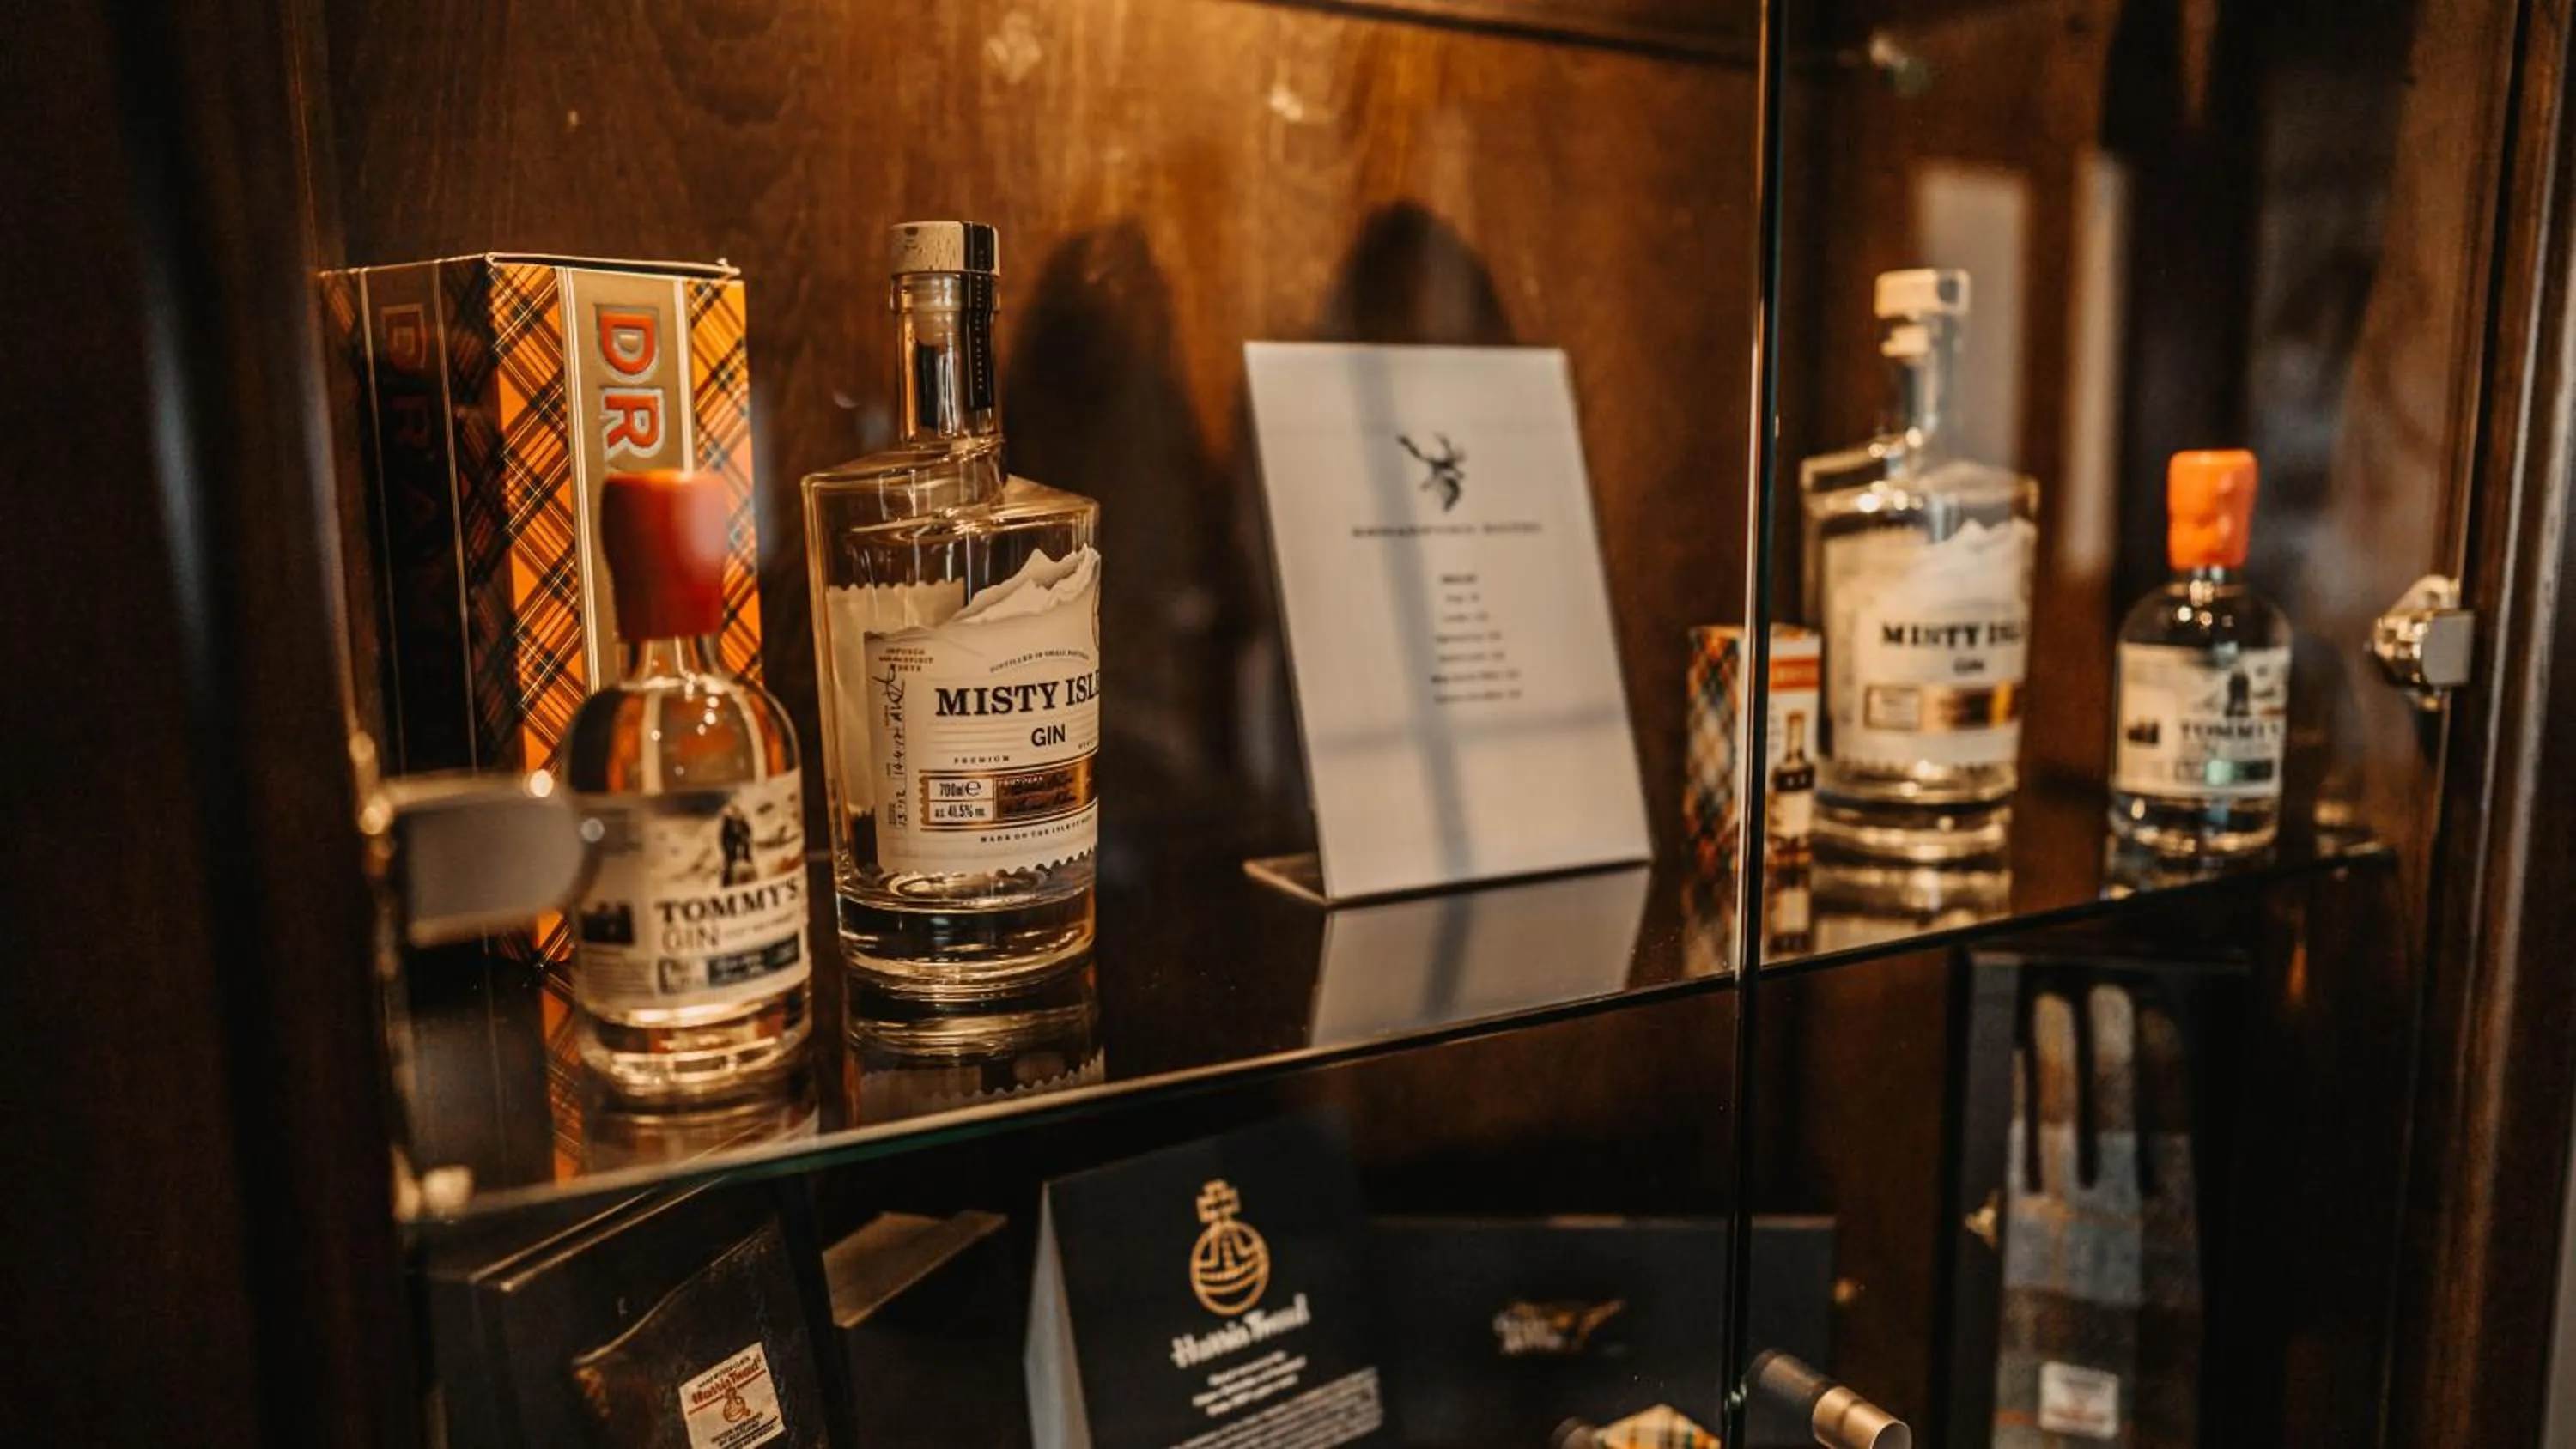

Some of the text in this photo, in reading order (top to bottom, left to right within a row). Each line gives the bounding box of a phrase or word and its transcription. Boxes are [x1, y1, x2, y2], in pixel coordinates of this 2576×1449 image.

[596, 303, 667, 464] DR
[1881, 623, 1979, 649] MISTY
[934, 681, 1060, 717] MISTY
[1031, 723, 1066, 748] GIN
[953, 755, 1011, 766] PREMIUM
[653, 876, 798, 925] TOMMY'S
